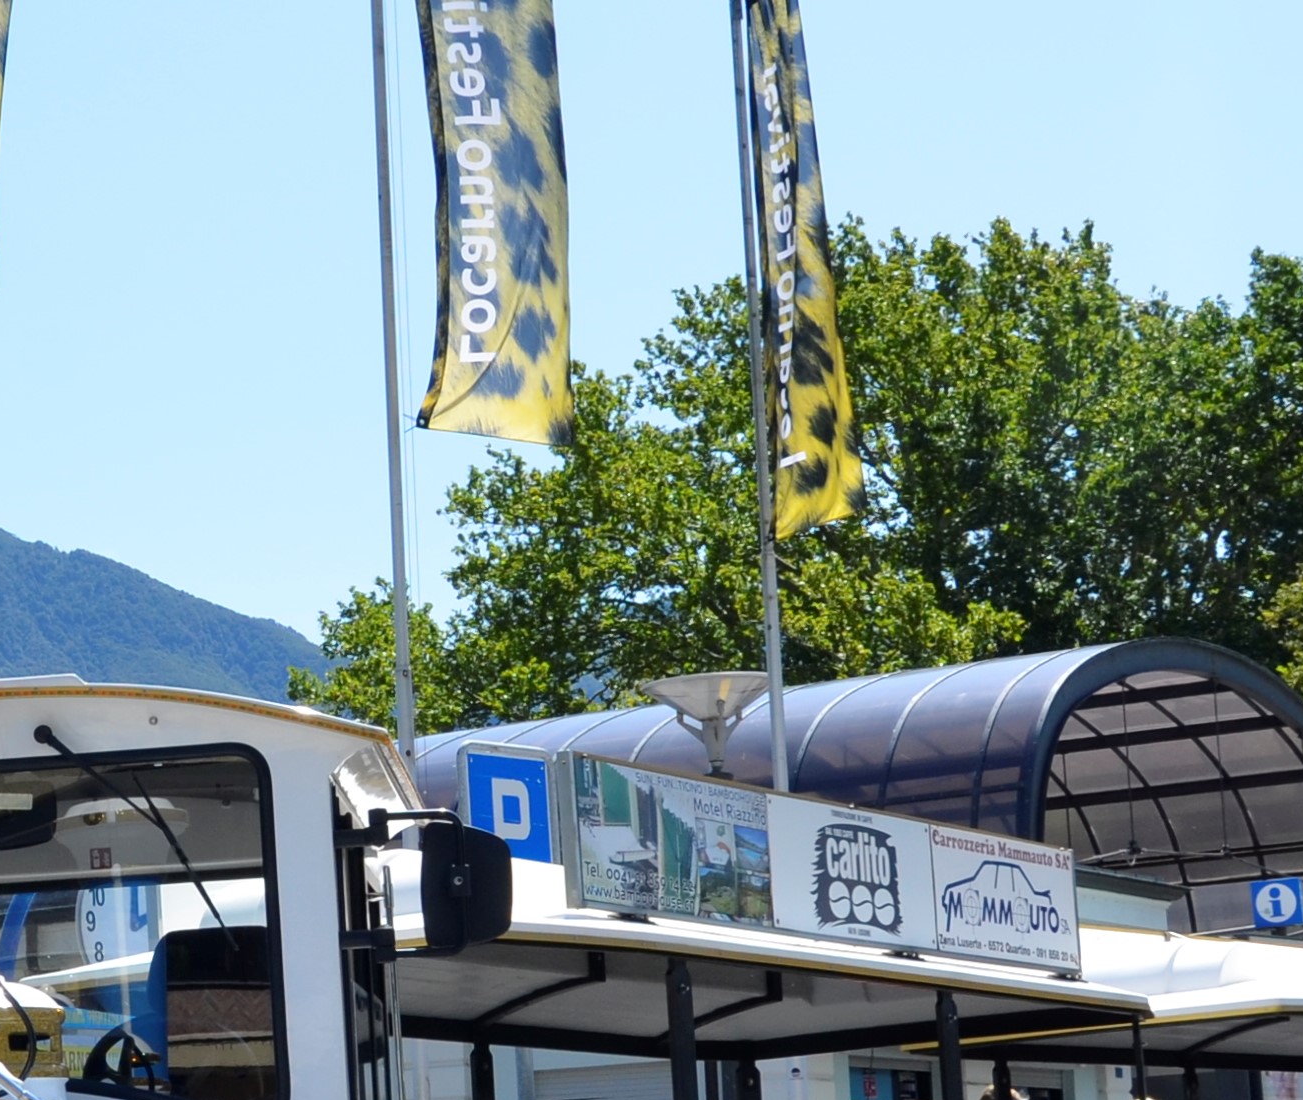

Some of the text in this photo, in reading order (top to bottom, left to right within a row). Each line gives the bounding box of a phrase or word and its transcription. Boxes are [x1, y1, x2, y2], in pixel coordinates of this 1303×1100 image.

[693, 798, 767, 826] Motel Riazzino
[825, 831, 891, 887] carlito
[932, 829, 995, 856] Carrozzeria
[998, 841, 1053, 867] Mammauto
[584, 861, 602, 878] Tel.
[606, 867, 631, 883] 0041
[85, 910, 96, 932] 9
[94, 941, 104, 963] 8
